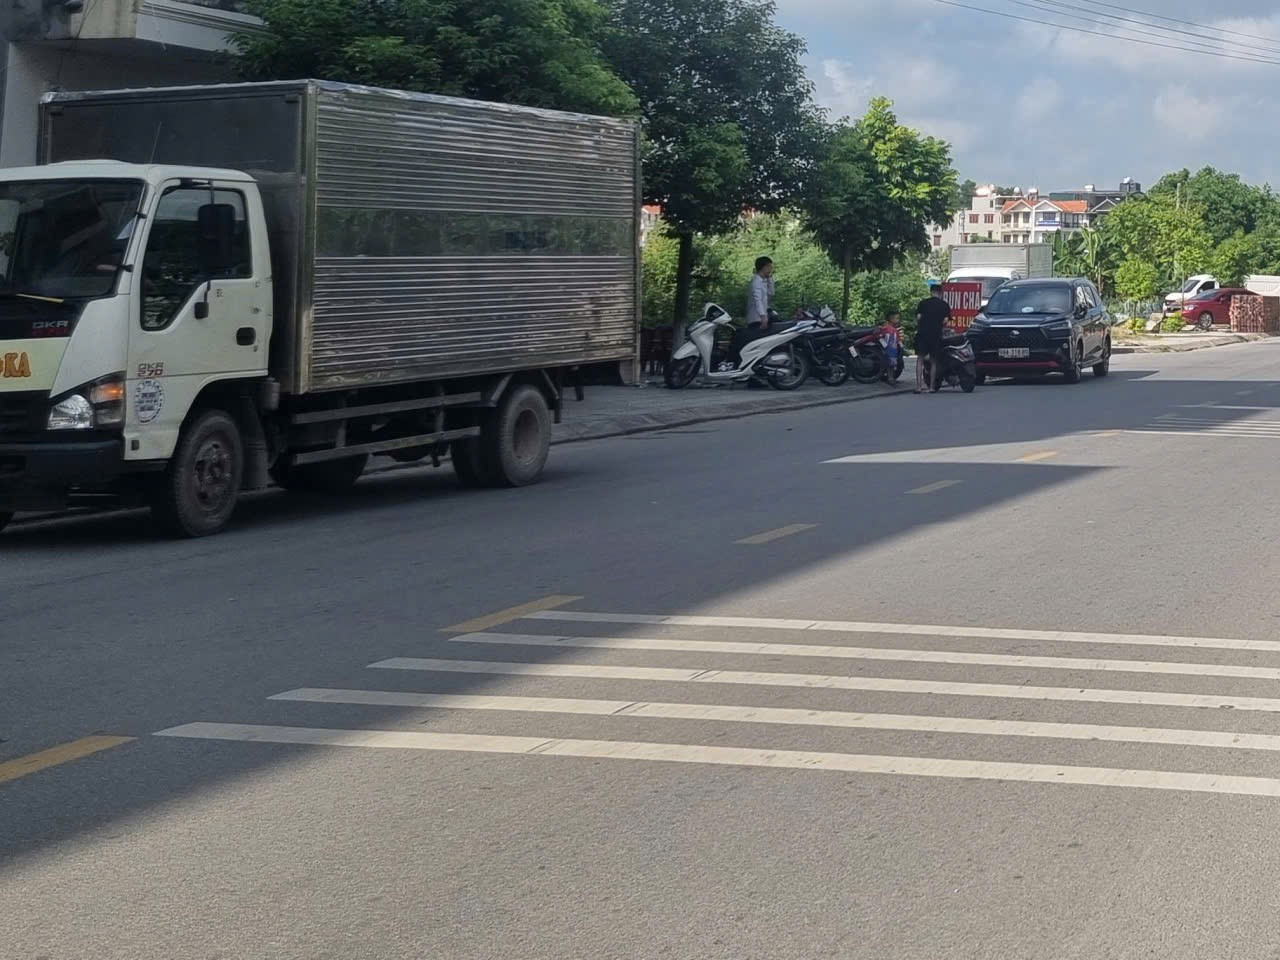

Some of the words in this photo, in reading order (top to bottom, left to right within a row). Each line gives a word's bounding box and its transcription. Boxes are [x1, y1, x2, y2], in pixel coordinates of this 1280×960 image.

[963, 283, 981, 309] CHẢ
[0, 351, 31, 378] KA
[137, 369, 164, 377] 270
